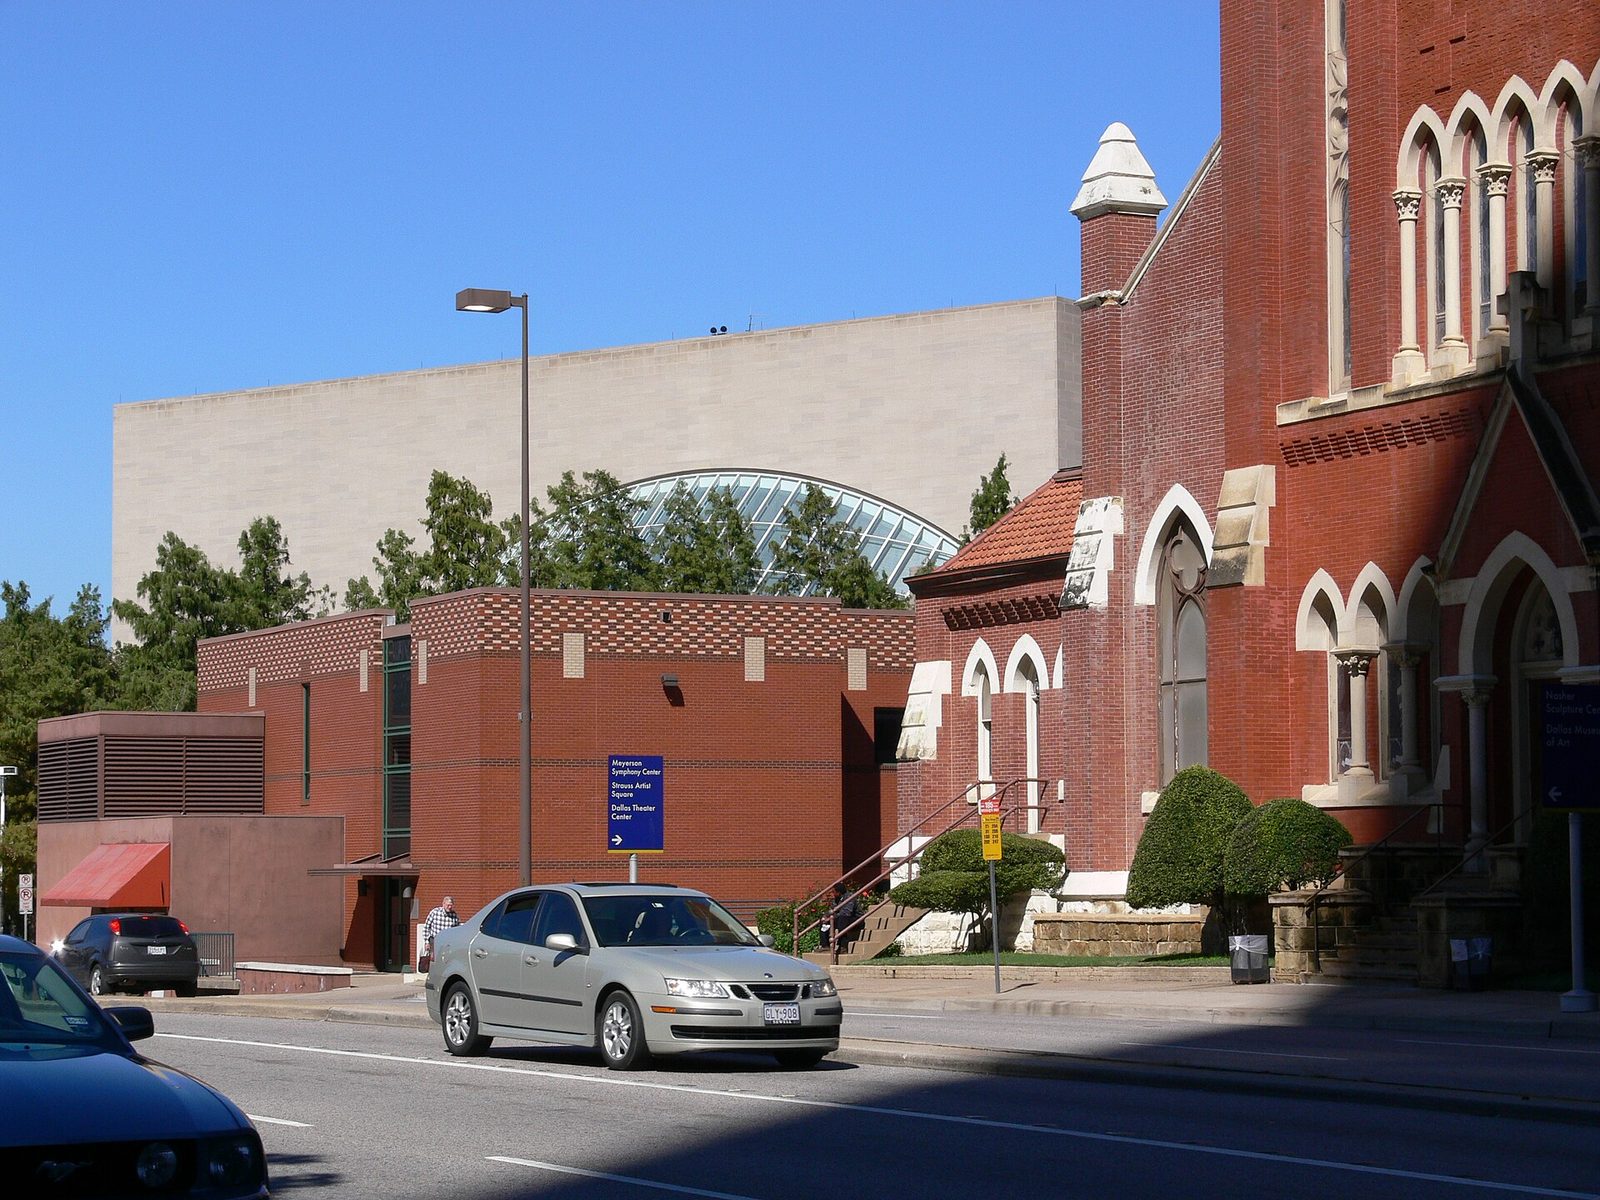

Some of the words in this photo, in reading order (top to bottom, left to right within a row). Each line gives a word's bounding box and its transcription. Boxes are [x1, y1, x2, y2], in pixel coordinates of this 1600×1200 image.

[1546, 689, 1575, 700] Nasher
[1546, 703, 1584, 716] Sculpture
[1546, 723, 1572, 734] Dallas
[1546, 736, 1555, 747] of
[1556, 737, 1570, 747] Art
[612, 759, 643, 768] Meyerson
[612, 768, 641, 777] Symphony
[642, 768, 661, 776] Center
[611, 790, 634, 799] Square
[612, 804, 631, 812] Dallas
[632, 804, 656, 812] Theater
